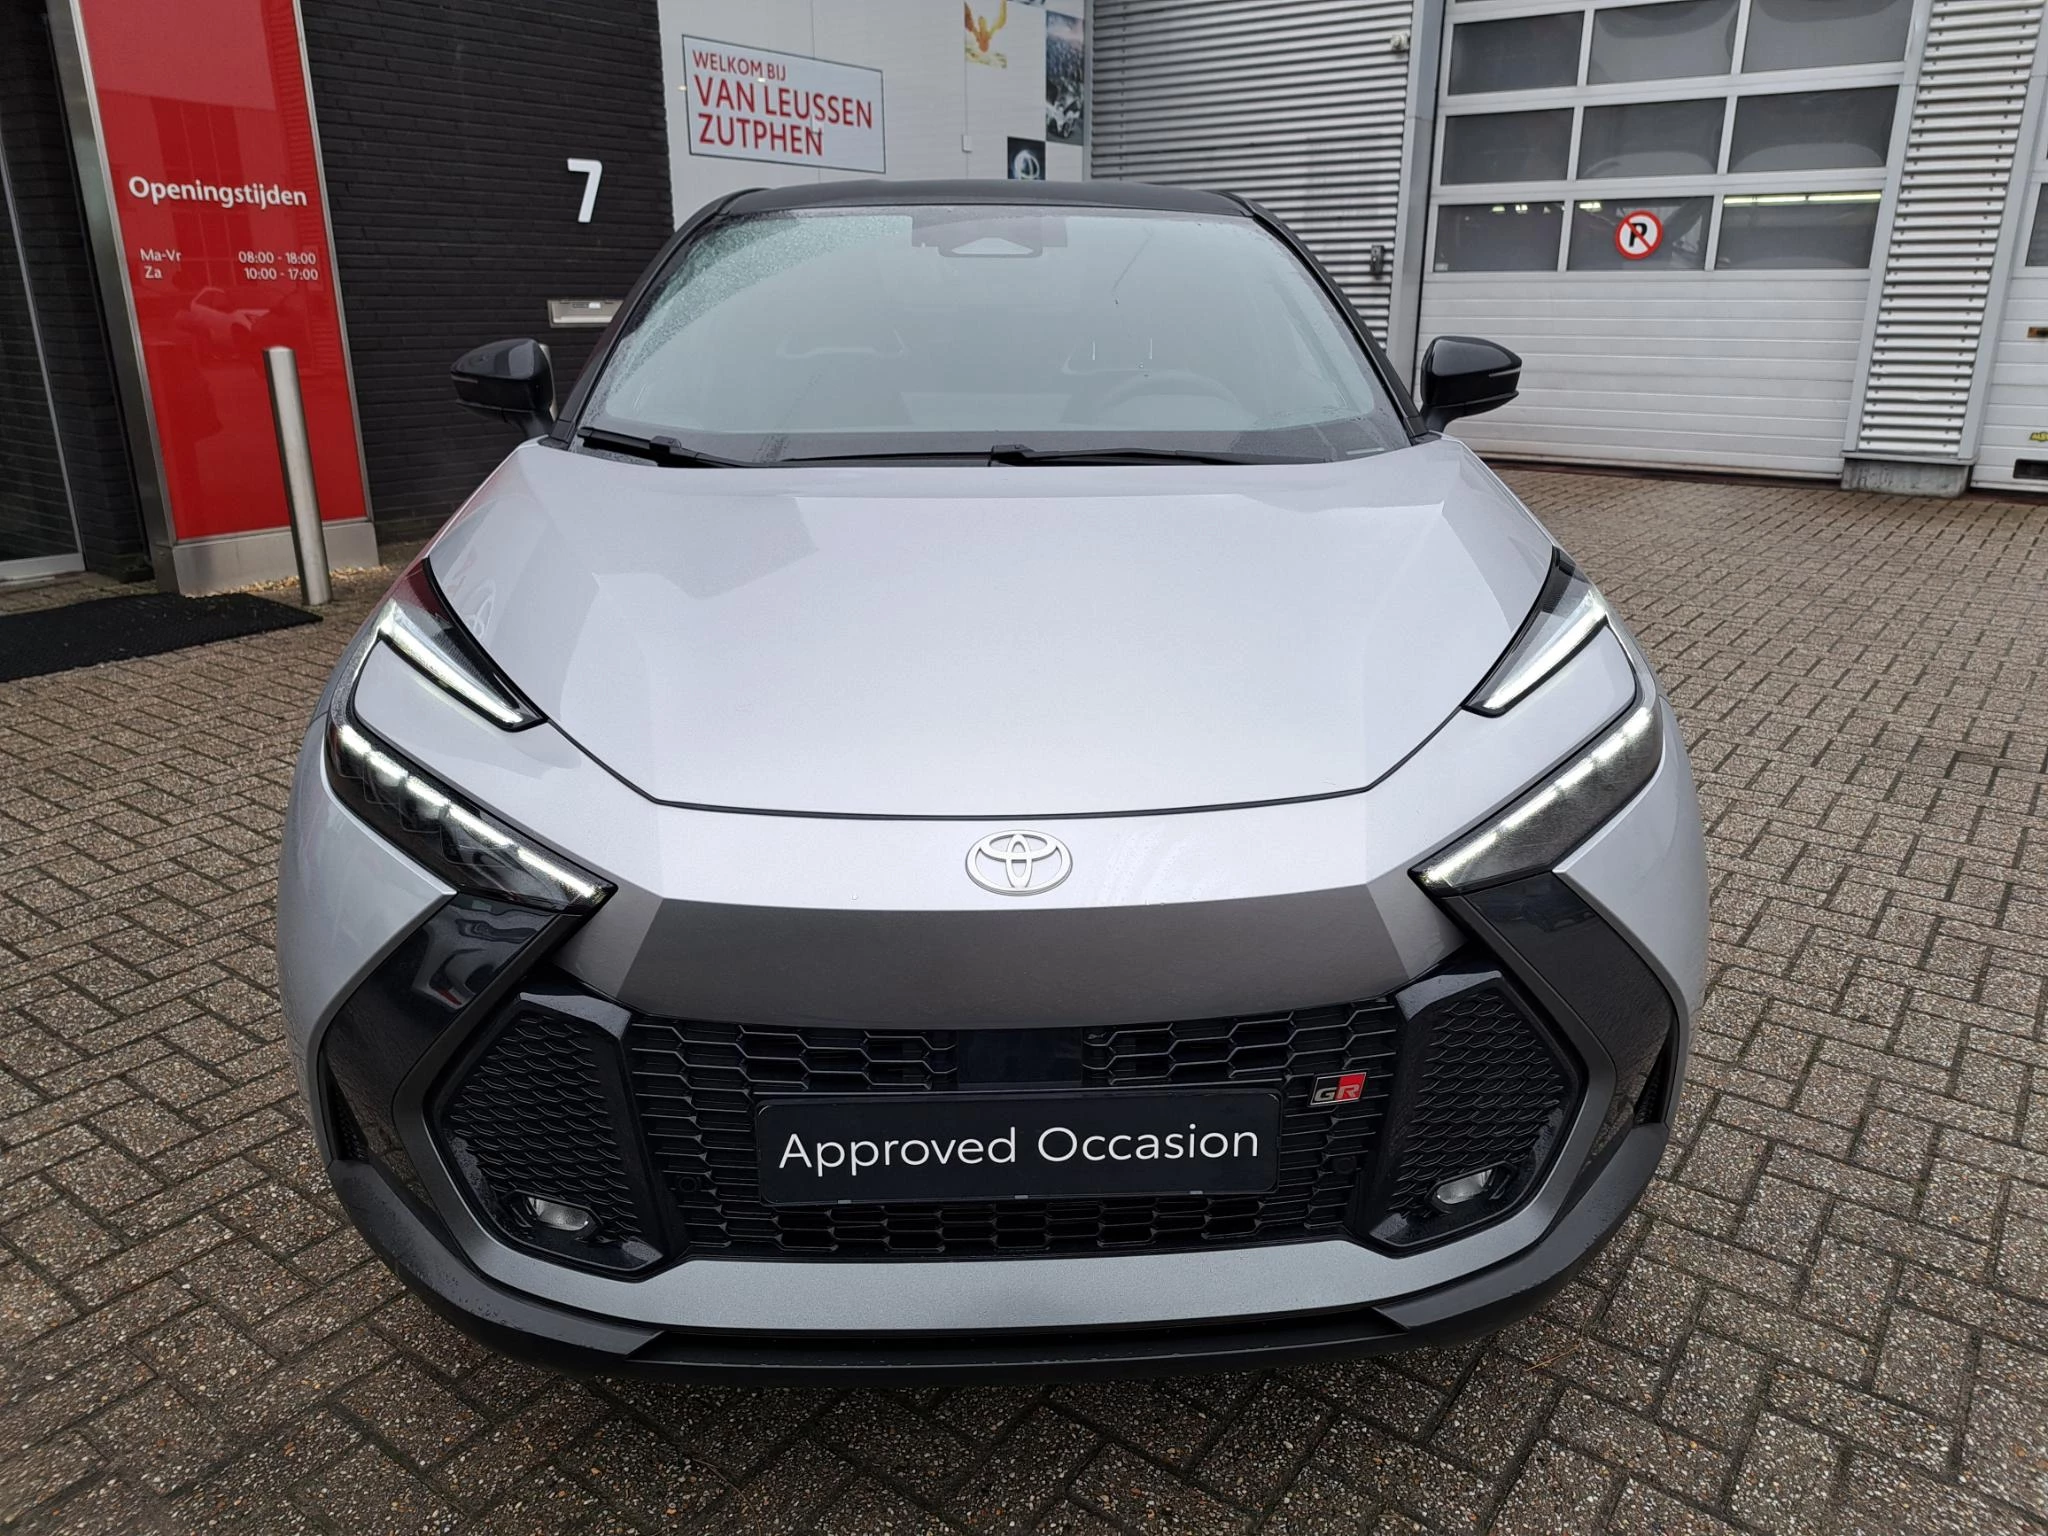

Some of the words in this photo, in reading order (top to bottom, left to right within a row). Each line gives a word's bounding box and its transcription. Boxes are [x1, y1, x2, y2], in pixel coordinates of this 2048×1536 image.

[692, 49, 763, 78] WELKOM
[767, 62, 786, 81] BIJ
[694, 74, 755, 113] VAN
[763, 85, 872, 129] LEUSSEN
[698, 113, 823, 156] ZUTPHEN
[128, 175, 307, 209] Openingstijden
[567, 158, 602, 223] 7
[1629, 222, 1648, 248] P
[139, 248, 182, 262] Ma-Vr
[238, 251, 274, 264] 08:00
[285, 251, 317, 265] 18:00
[144, 265, 163, 279] Za
[244, 266, 277, 280] 10:00
[288, 267, 319, 281] 17:00
[1314, 1084, 1361, 1102] GR
[778, 1126, 1017, 1178] Approved
[1037, 1123, 1259, 1163] Occasion
